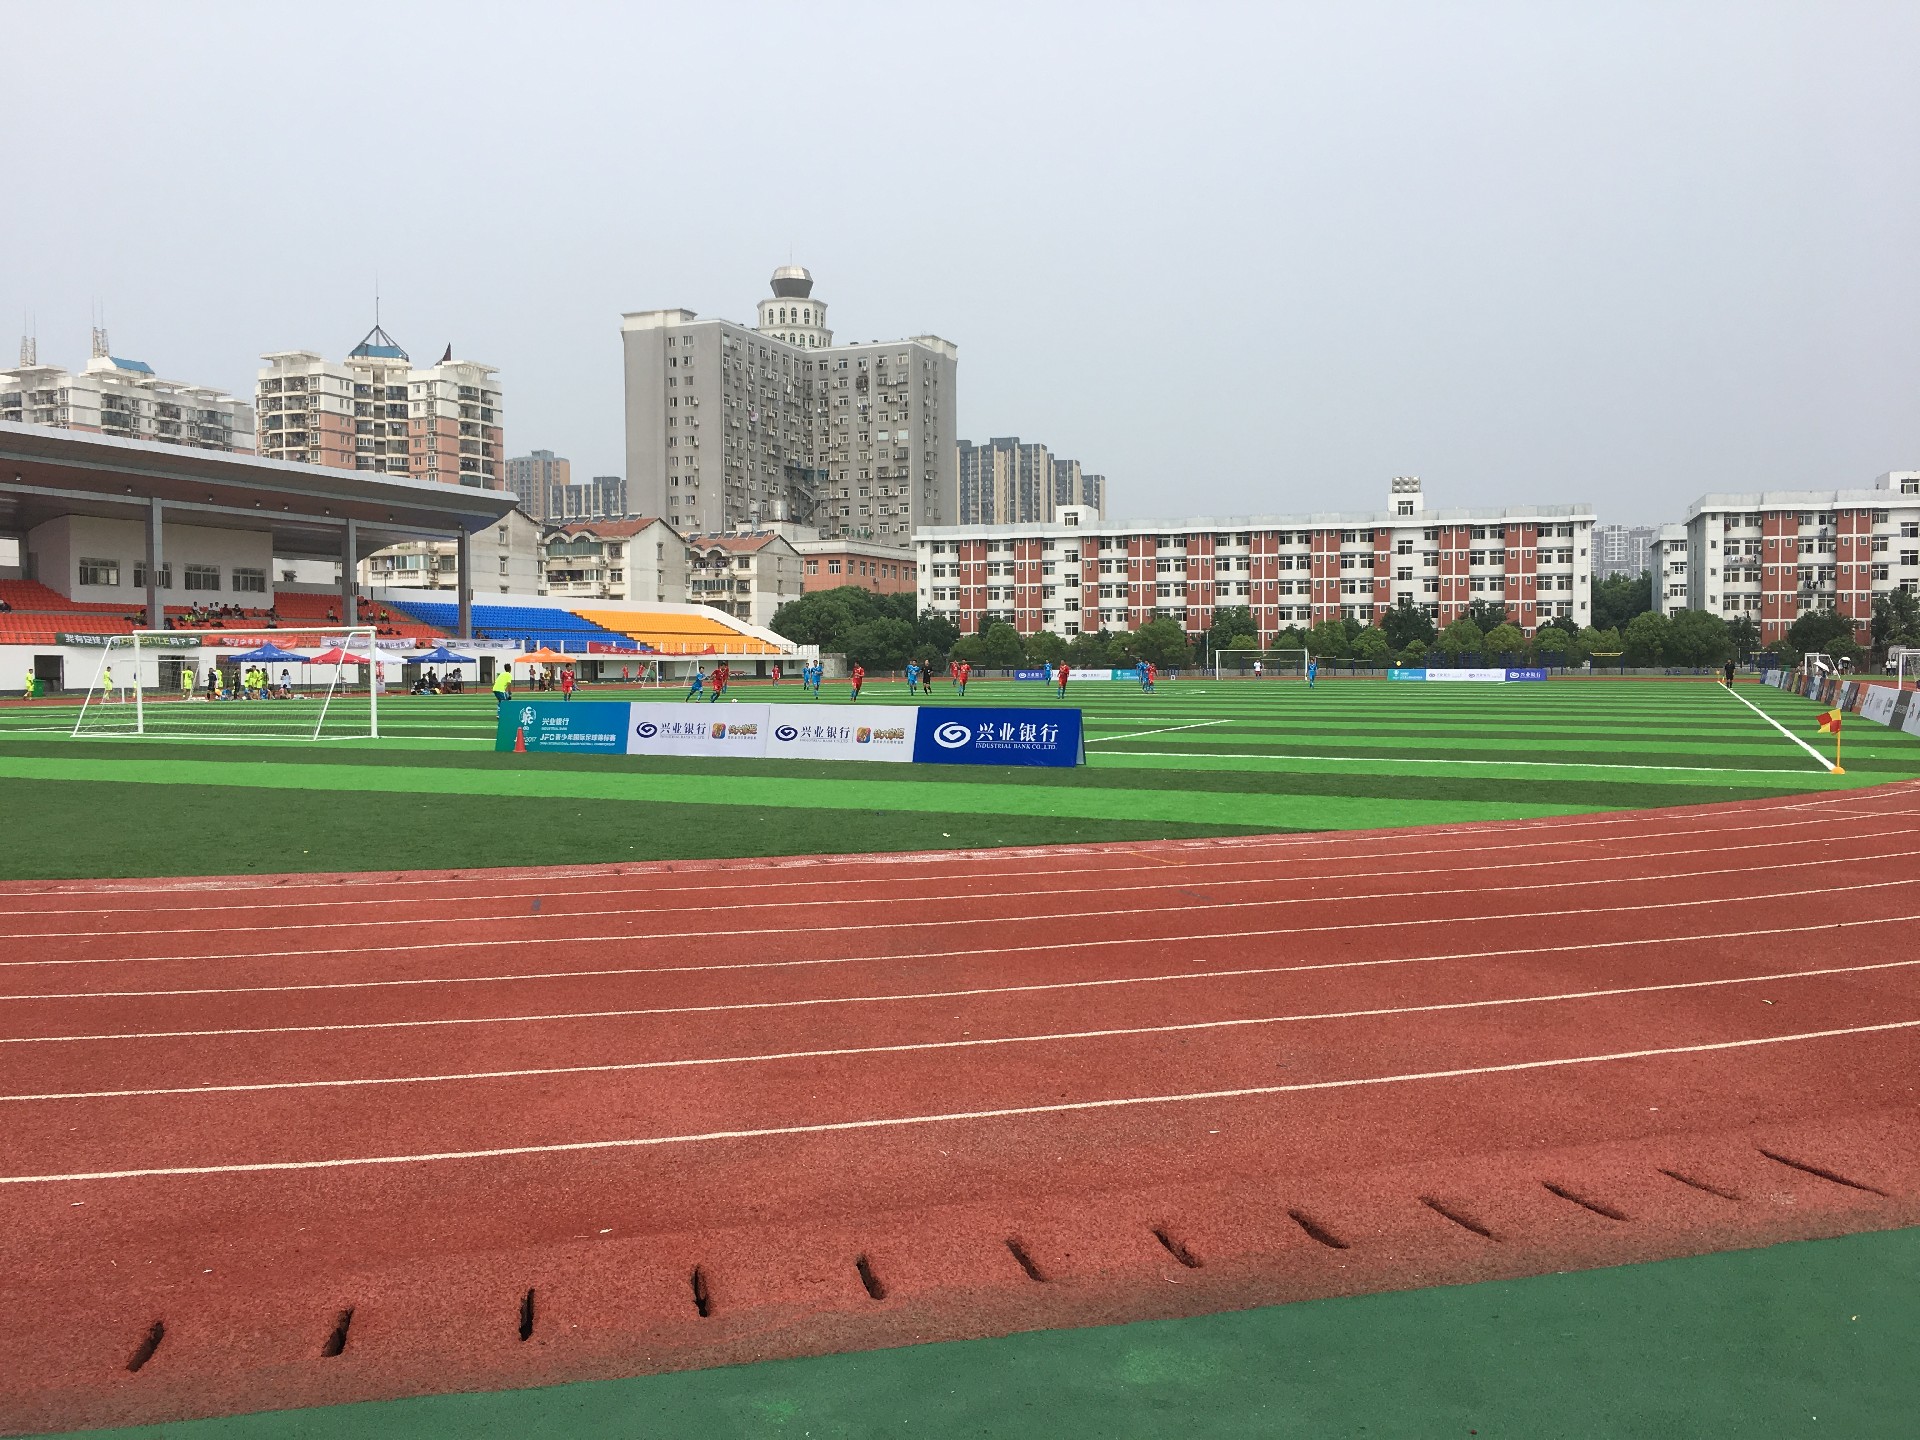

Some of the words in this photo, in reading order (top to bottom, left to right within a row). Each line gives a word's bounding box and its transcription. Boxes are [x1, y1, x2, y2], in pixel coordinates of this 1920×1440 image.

[659, 722, 706, 735] 兴业银行
[800, 725, 851, 739] 兴业银行
[976, 722, 1059, 743] 兴业银行
